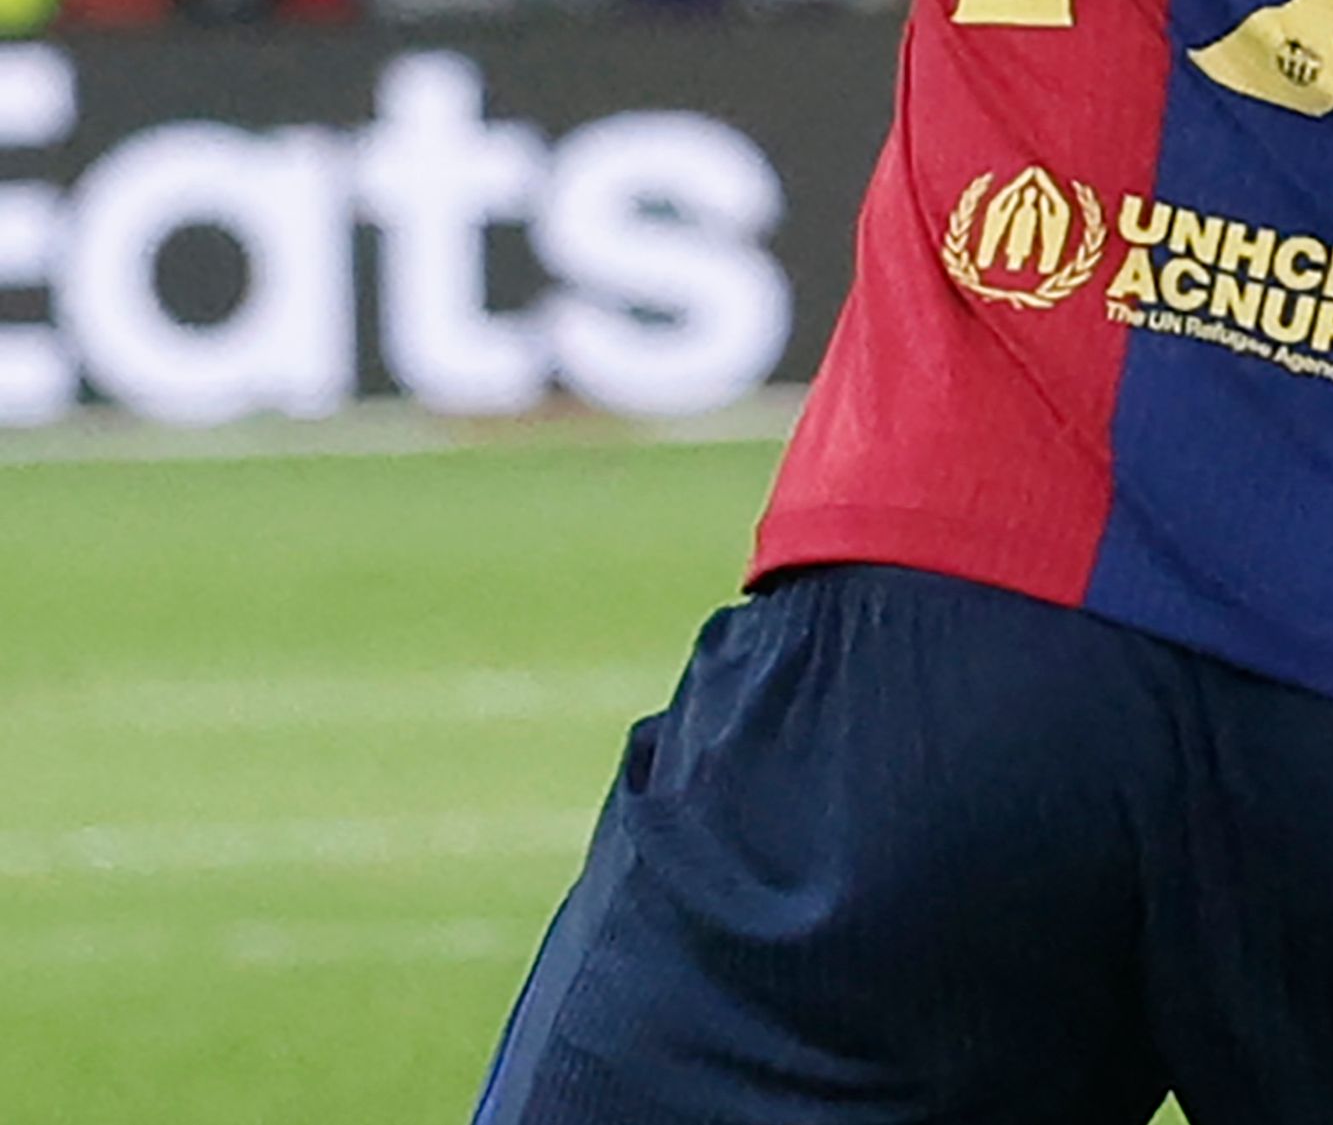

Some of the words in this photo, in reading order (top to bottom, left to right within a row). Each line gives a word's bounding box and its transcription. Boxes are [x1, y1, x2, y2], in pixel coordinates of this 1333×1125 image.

[1106, 300, 1146, 327] The
[1149, 310, 1182, 335] UN
[1185, 315, 1273, 357] Refugee
